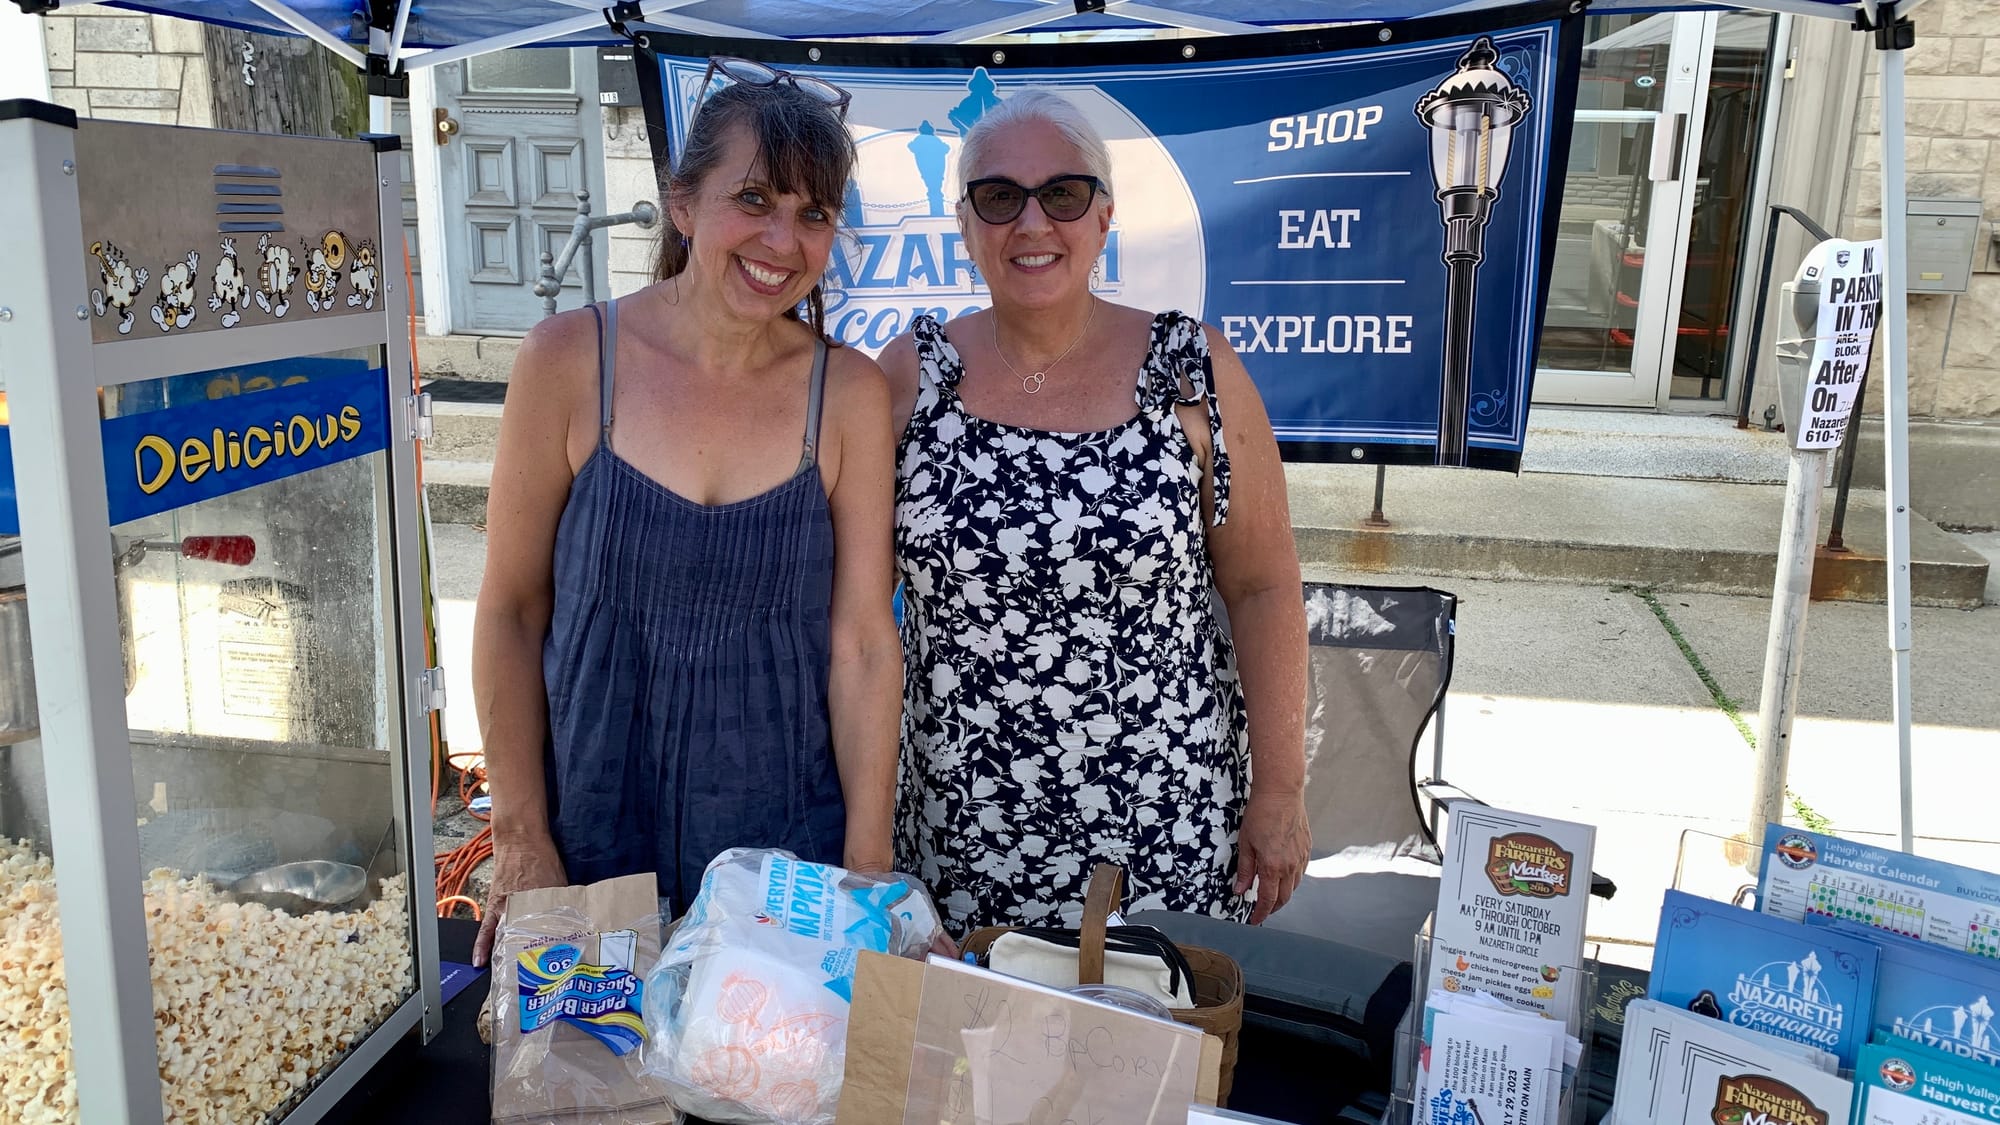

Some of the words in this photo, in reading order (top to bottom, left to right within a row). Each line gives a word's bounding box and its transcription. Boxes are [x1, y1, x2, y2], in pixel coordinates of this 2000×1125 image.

[1267, 106, 1384, 152] SHOP
[1277, 208, 1361, 249] EAT
[1835, 305, 1855, 332] IN
[1221, 315, 1413, 353] EXPLORE
[1836, 333, 1858, 344] AREA
[1834, 345, 1861, 358] BLOCK
[1815, 360, 1859, 386] After
[1811, 387, 1838, 412] On
[134, 404, 362, 495] Delicious
[1494, 844, 1567, 870] FARMERS
[1507, 840, 1556, 857] Nazareth
[1825, 841, 1858, 857] Lehigh
[1860, 850, 1889, 865] Valley
[1509, 861, 1565, 887] Market
[1823, 852, 1875, 873] Harvest
[1877, 865, 1941, 888] Calendar
[765, 856, 789, 918] EVERYDAY
[1475, 894, 1503, 910] EVERY
[1505, 901, 1551, 920] SATURDAY
[1460, 904, 1478, 917] MAY
[1480, 908, 1519, 927] THROUGH
[1521, 917, 1561, 936] OCTOBER
[1475, 920, 1482, 931] 9
[1484, 922, 1495, 934] AM
[1497, 925, 1521, 941] UNTIL
[1524, 931, 1528, 942] 1
[1529, 932, 1542, 945] PM
[1479, 935, 1515, 952] NAZARETH
[1515, 944, 1540, 957] CIRCLE
[548, 958, 573, 973] 30
[821, 950, 838, 973] 250
[1469, 950, 1490, 962] fruits
[1492, 957, 1539, 973] microgreens
[597, 973, 637, 995] SACS
[1468, 973, 1483, 984] jam
[1485, 978, 1512, 989] pickles
[1514, 984, 1532, 995] eggs
[1470, 962, 1499, 975] chicken
[1502, 970, 1519, 980] beef
[1521, 975, 1540, 985] pork
[526, 979, 575, 1011] PAPIER
[578, 979, 594, 994] EN
[539, 998, 578, 1025] BAGS
[580, 995, 628, 1016] PAPER
[1490, 990, 1514, 1002] kiffles
[1516, 997, 1546, 1010] cookies
[1734, 980, 1843, 1030] NAZARETH
[1728, 993, 1839, 1046] Economic
[1445, 1045, 1453, 1067] moving
[1464, 1040, 1472, 1058] Street
[1480, 1048, 1489, 1063] Main
[1500, 1045, 1508, 1062] home
[1461, 1060, 1470, 1074] Main
[1471, 1071, 1479, 1084] July
[1489, 1082, 1495, 1092] am
[1492, 1051, 1498, 1061] pm
[1499, 1072, 1505, 1080] we
[1500, 1063, 1507, 1071] go
[1444, 1080, 1450, 1088] we
[1460, 1076, 1468, 1094] South
[1479, 1074, 1487, 1094] Martin
[1507, 1070, 1517, 1094] 2023
[1523, 1068, 1532, 1092] MAIN
[1923, 1072, 1963, 1092] Lehigh
[1505, 1097, 1516, 1110] 29,
[1521, 1093, 1530, 1107] ON
[1725, 1085, 1818, 1125] FARMERS
[1742, 1083, 1806, 1114] Nazareth
[1922, 1084, 1986, 1114] Harvest
